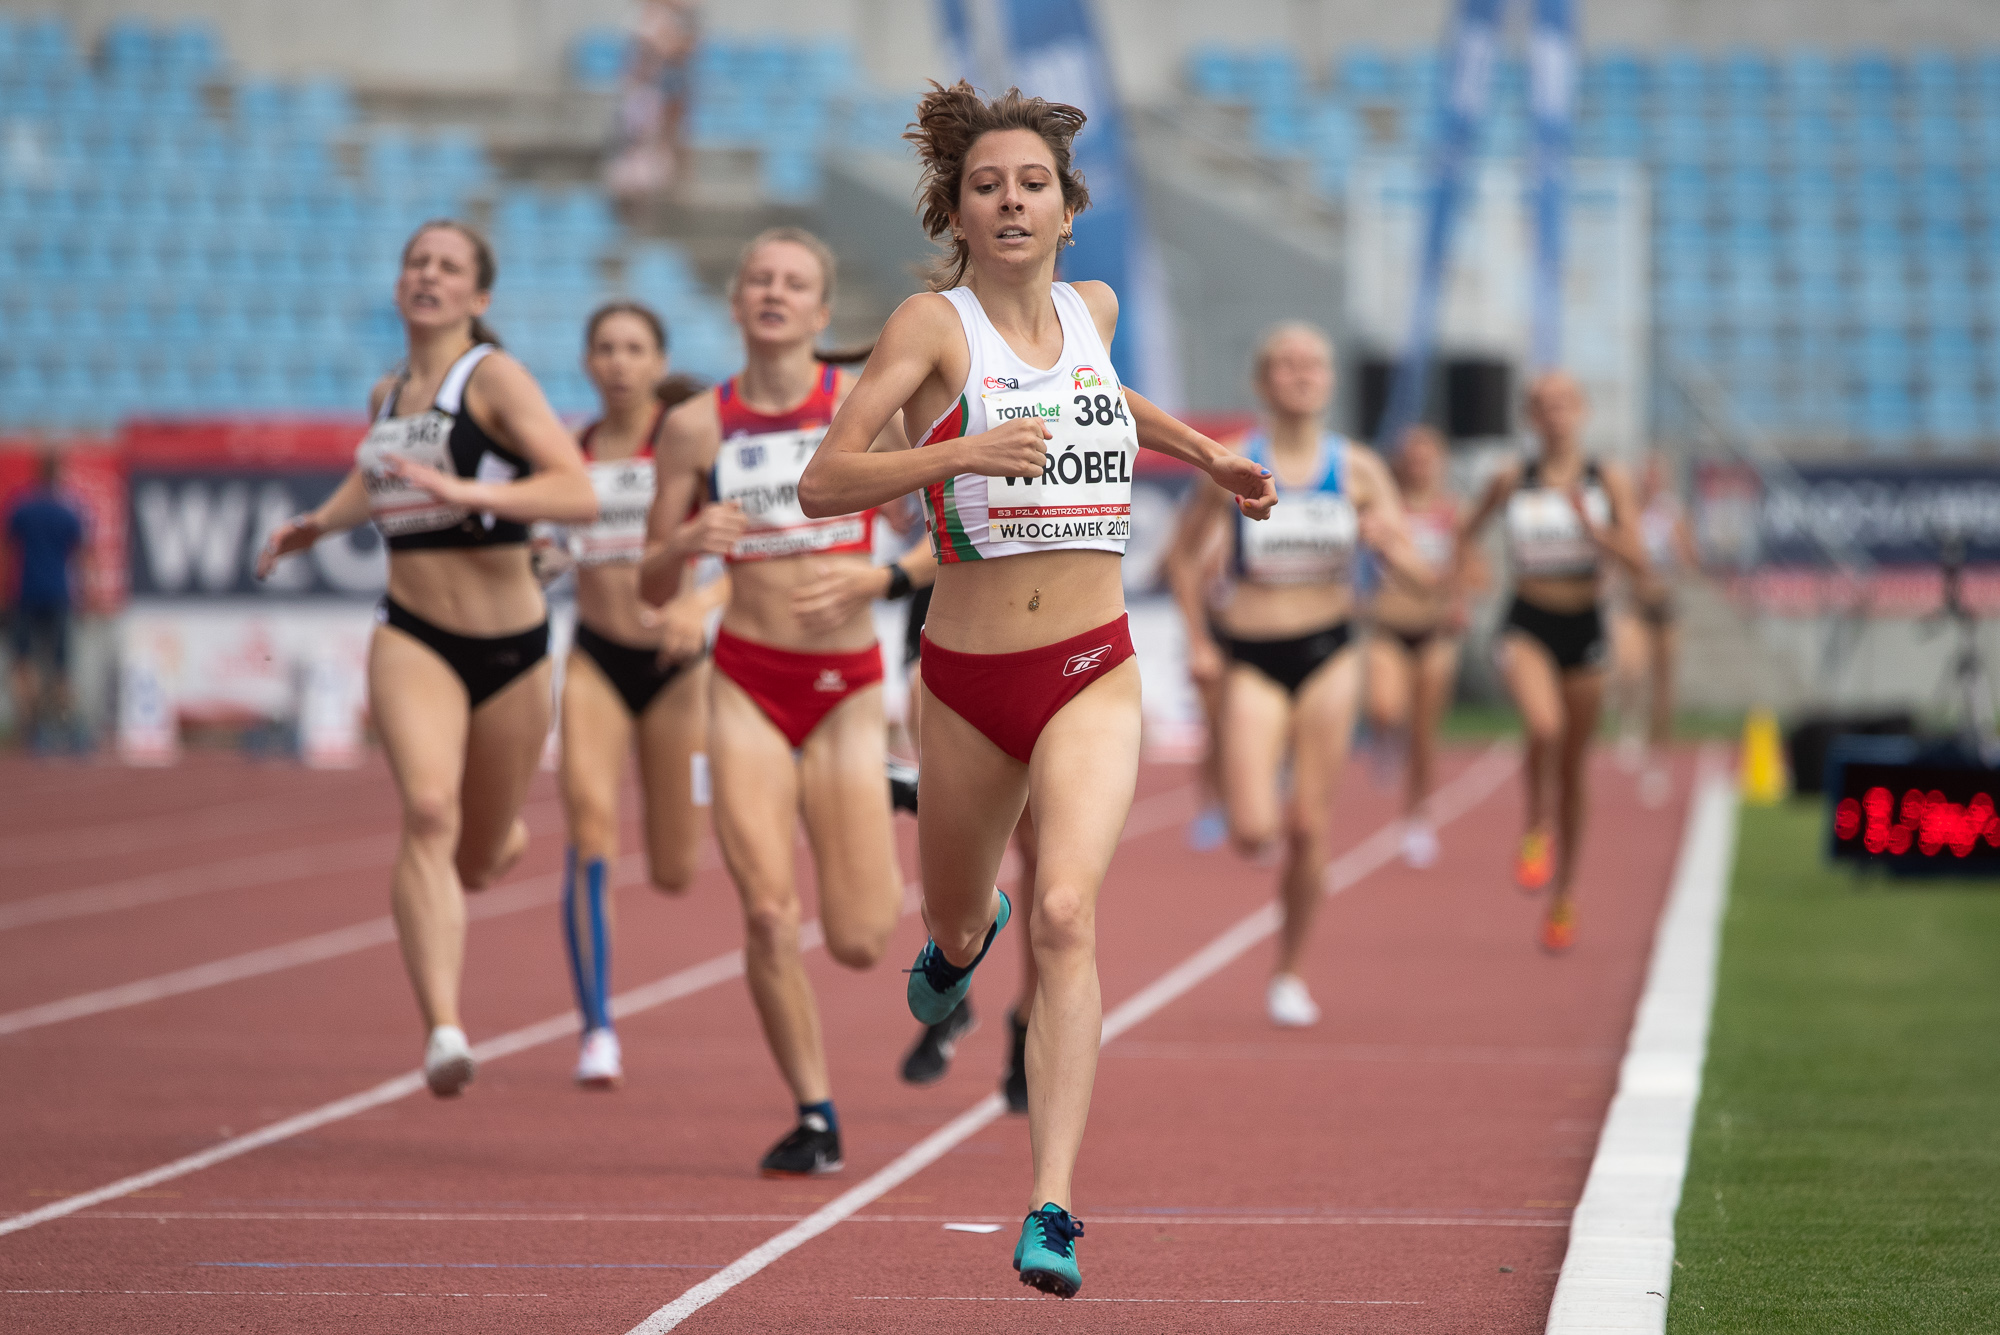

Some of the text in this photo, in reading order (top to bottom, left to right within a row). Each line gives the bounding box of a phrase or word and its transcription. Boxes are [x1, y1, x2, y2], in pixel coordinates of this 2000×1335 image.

[984, 376, 1020, 390] esa
[996, 402, 1061, 420] TOTALbet
[1074, 394, 1129, 427] 384
[1004, 444, 1130, 487] RÓBEL
[1015, 508, 1040, 516] PZLA
[1041, 507, 1099, 516] MISTRZOSTWA
[1100, 506, 1122, 514] POLSKI
[1000, 520, 1129, 539] WŁOCŁAWEK 2021
